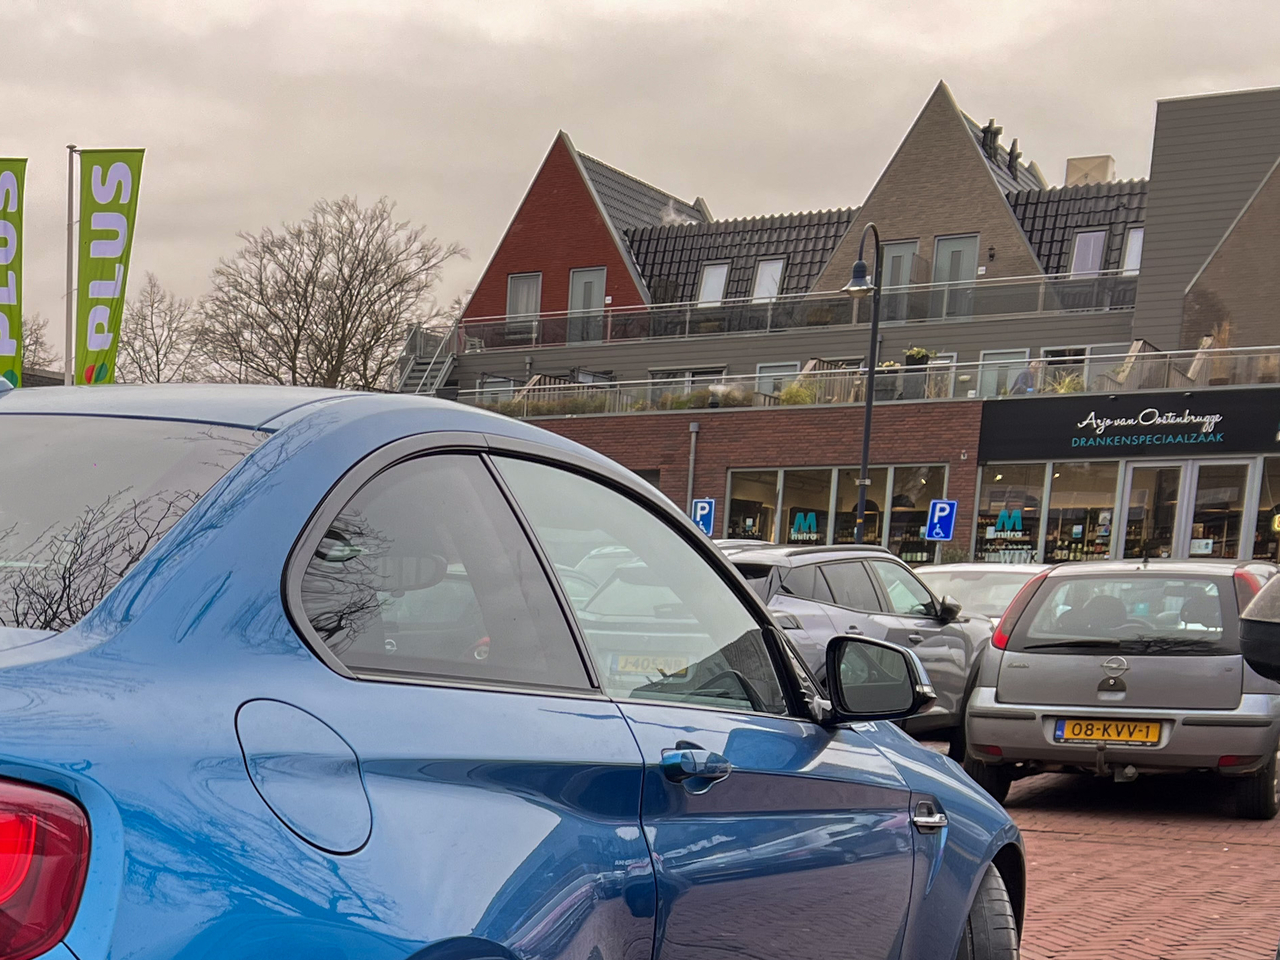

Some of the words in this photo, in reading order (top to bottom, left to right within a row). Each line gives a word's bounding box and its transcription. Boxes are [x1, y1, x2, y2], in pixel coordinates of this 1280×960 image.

[87, 161, 132, 351] PLUS
[1077, 411, 1113, 434] Arjo
[1114, 417, 1138, 426] van
[1138, 408, 1223, 433] Oostenbrugge
[1071, 431, 1225, 447] DRANKENSPECIAALZAAK
[696, 502, 710, 521] P
[933, 503, 950, 523] P
[995, 530, 1022, 538] mitra
[1071, 722, 1150, 739] 08-KVV-1
